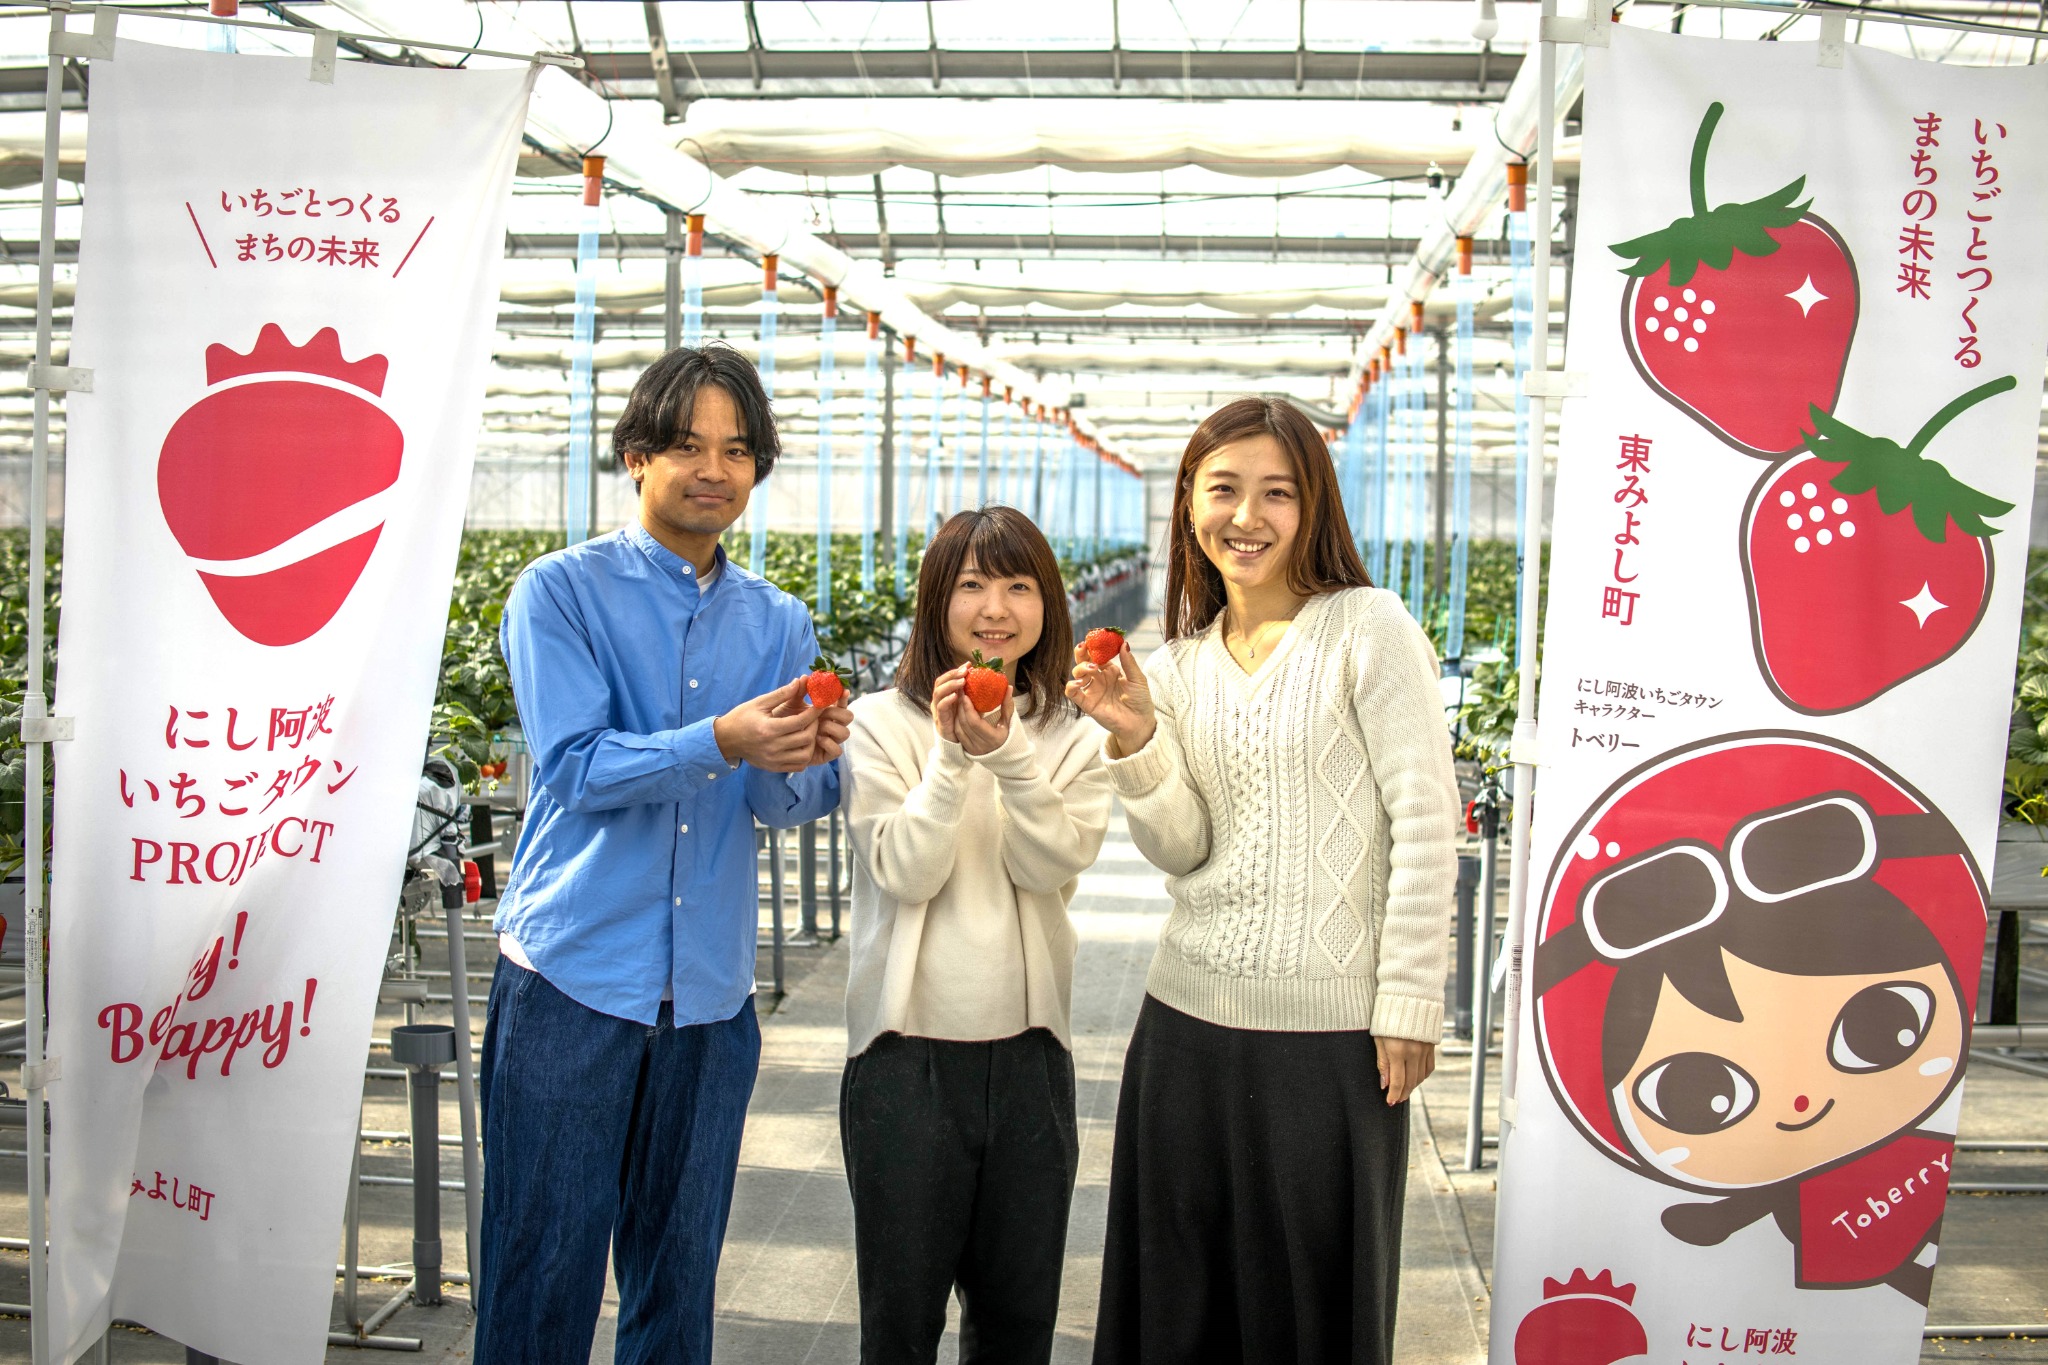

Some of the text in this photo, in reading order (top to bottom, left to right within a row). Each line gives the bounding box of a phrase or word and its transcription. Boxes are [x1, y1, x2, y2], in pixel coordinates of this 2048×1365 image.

[221, 188, 401, 224] いちごとつくる
[1896, 112, 1941, 300] まちの未来
[236, 233, 380, 269] まちの未来
[1955, 119, 2007, 369] いちごとつくる
[1602, 433, 1653, 627] 東みよし町
[1573, 699, 1656, 720] キャラクター
[1577, 677, 1724, 709] にし阿波いちごタウン
[166, 693, 335, 751] にし阿波
[1571, 727, 1640, 753] トベリー
[119, 754, 359, 819] いちごタウン
[130, 816, 334, 886] PROJECT
[1687, 1322, 1798, 1355] にし阿波
